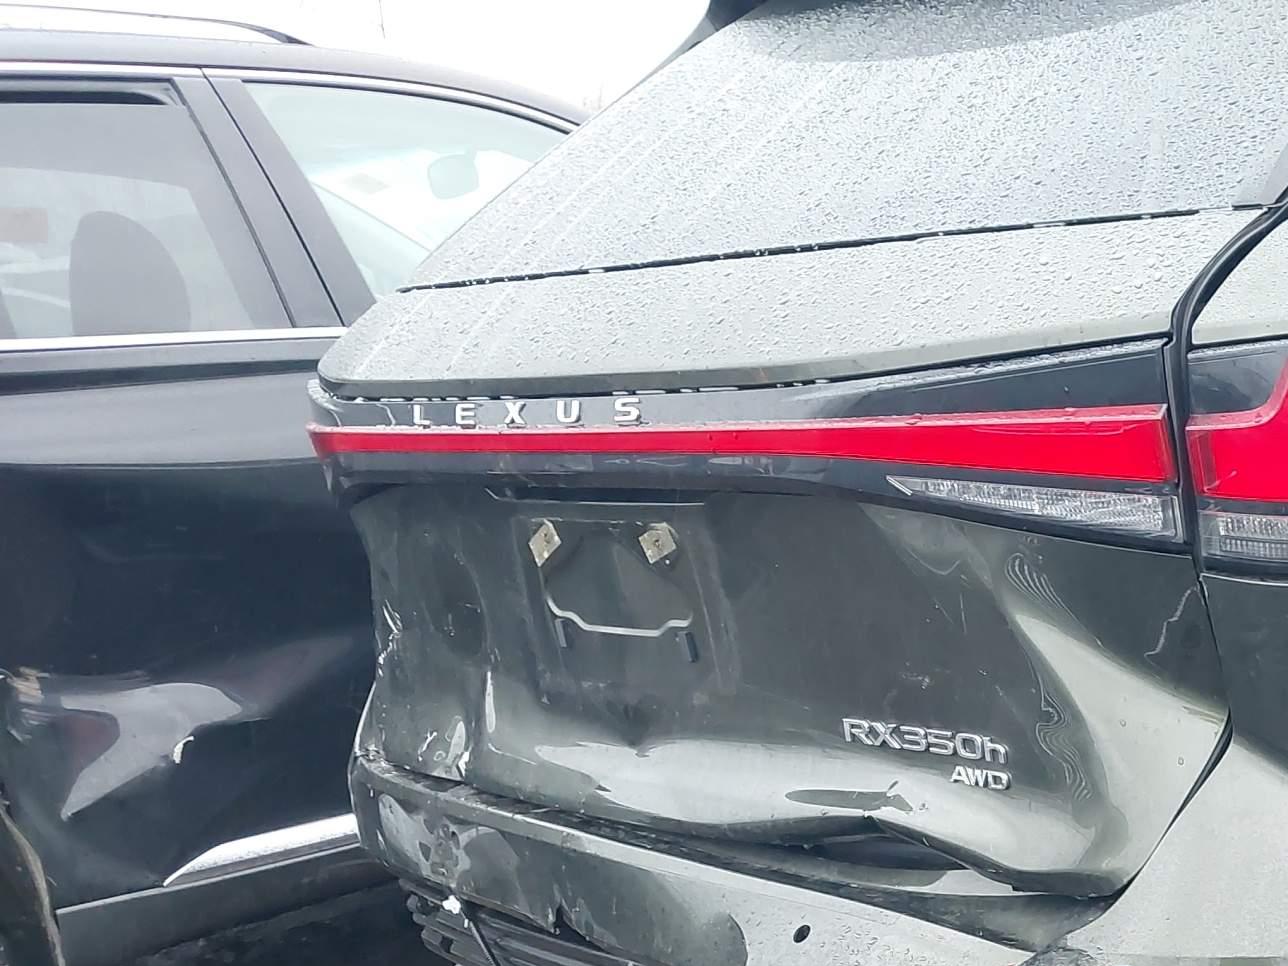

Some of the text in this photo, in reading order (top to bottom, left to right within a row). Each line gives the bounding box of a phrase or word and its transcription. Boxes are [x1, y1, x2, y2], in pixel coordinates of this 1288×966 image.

[412, 397, 642, 426] LEXUS
[841, 717, 1009, 765] RX350h
[949, 764, 1012, 791] AWD
